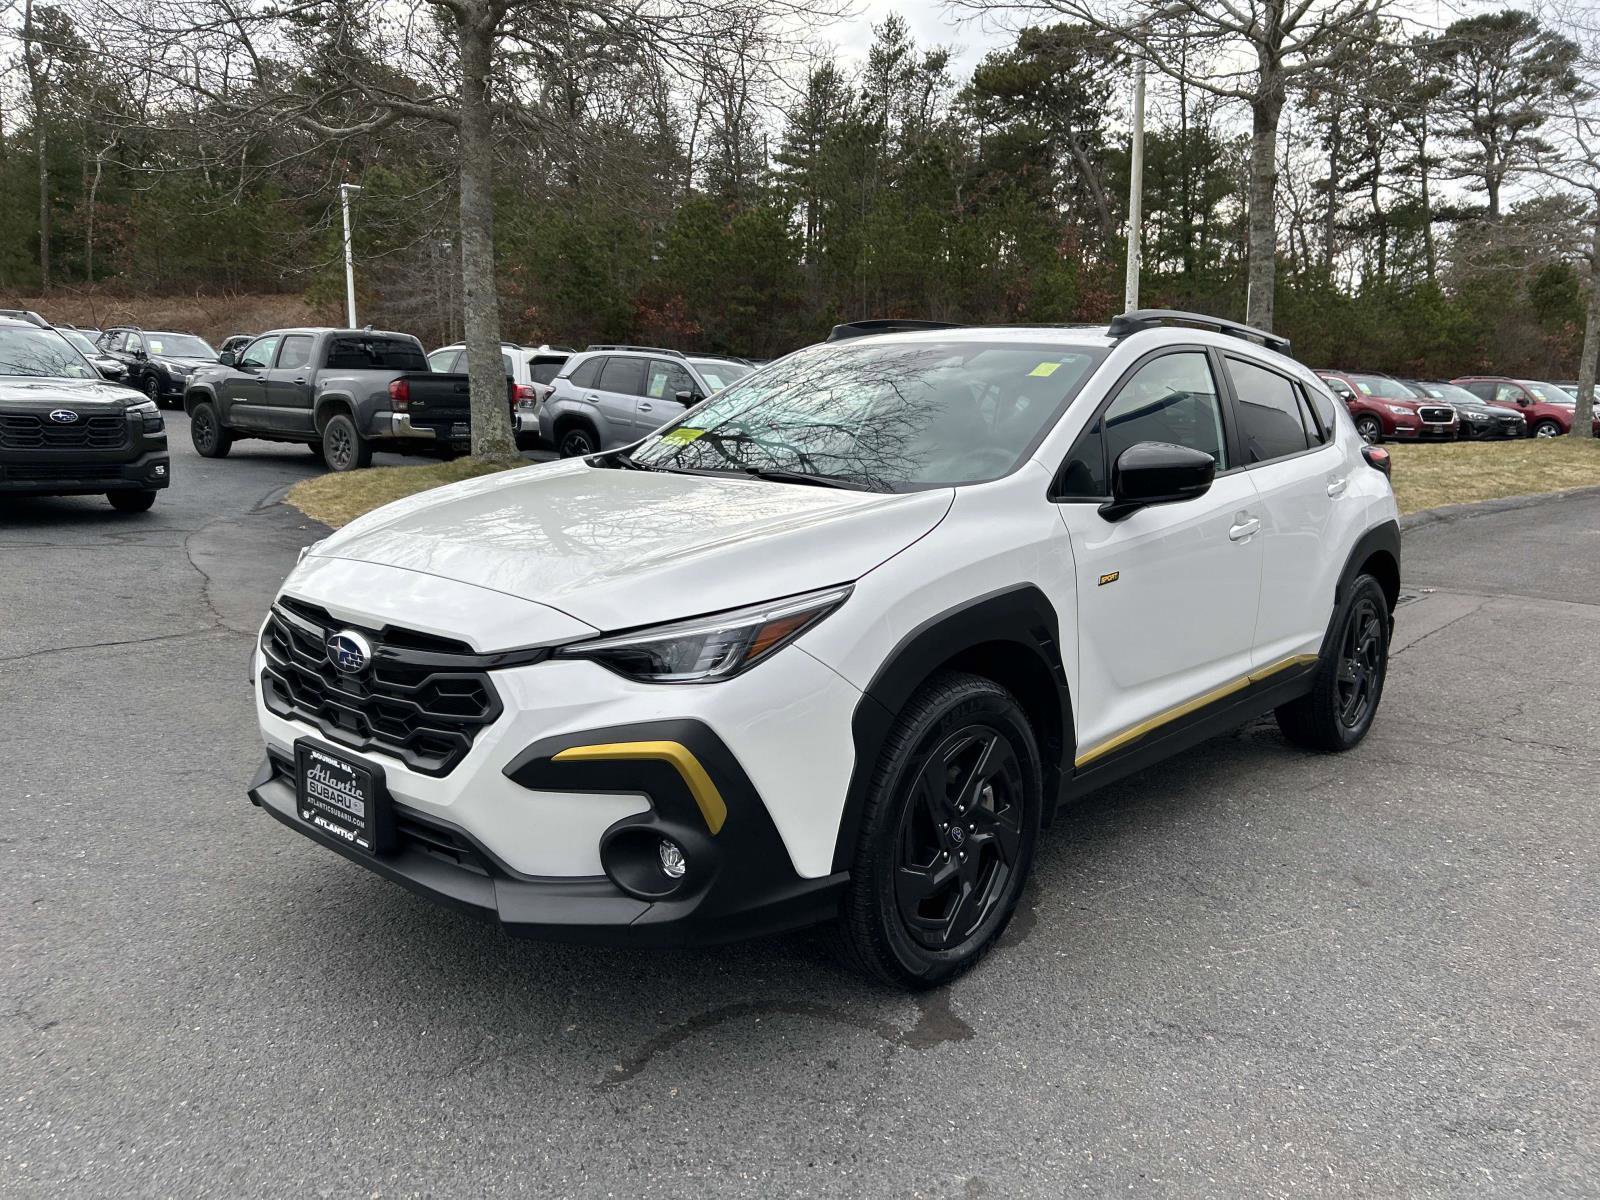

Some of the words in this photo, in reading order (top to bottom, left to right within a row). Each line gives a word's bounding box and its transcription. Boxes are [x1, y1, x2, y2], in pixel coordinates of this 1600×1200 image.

[1101, 573, 1119, 584] SPORT
[307, 764, 364, 800] Atlantic
[309, 782, 352, 809] SUBARU
